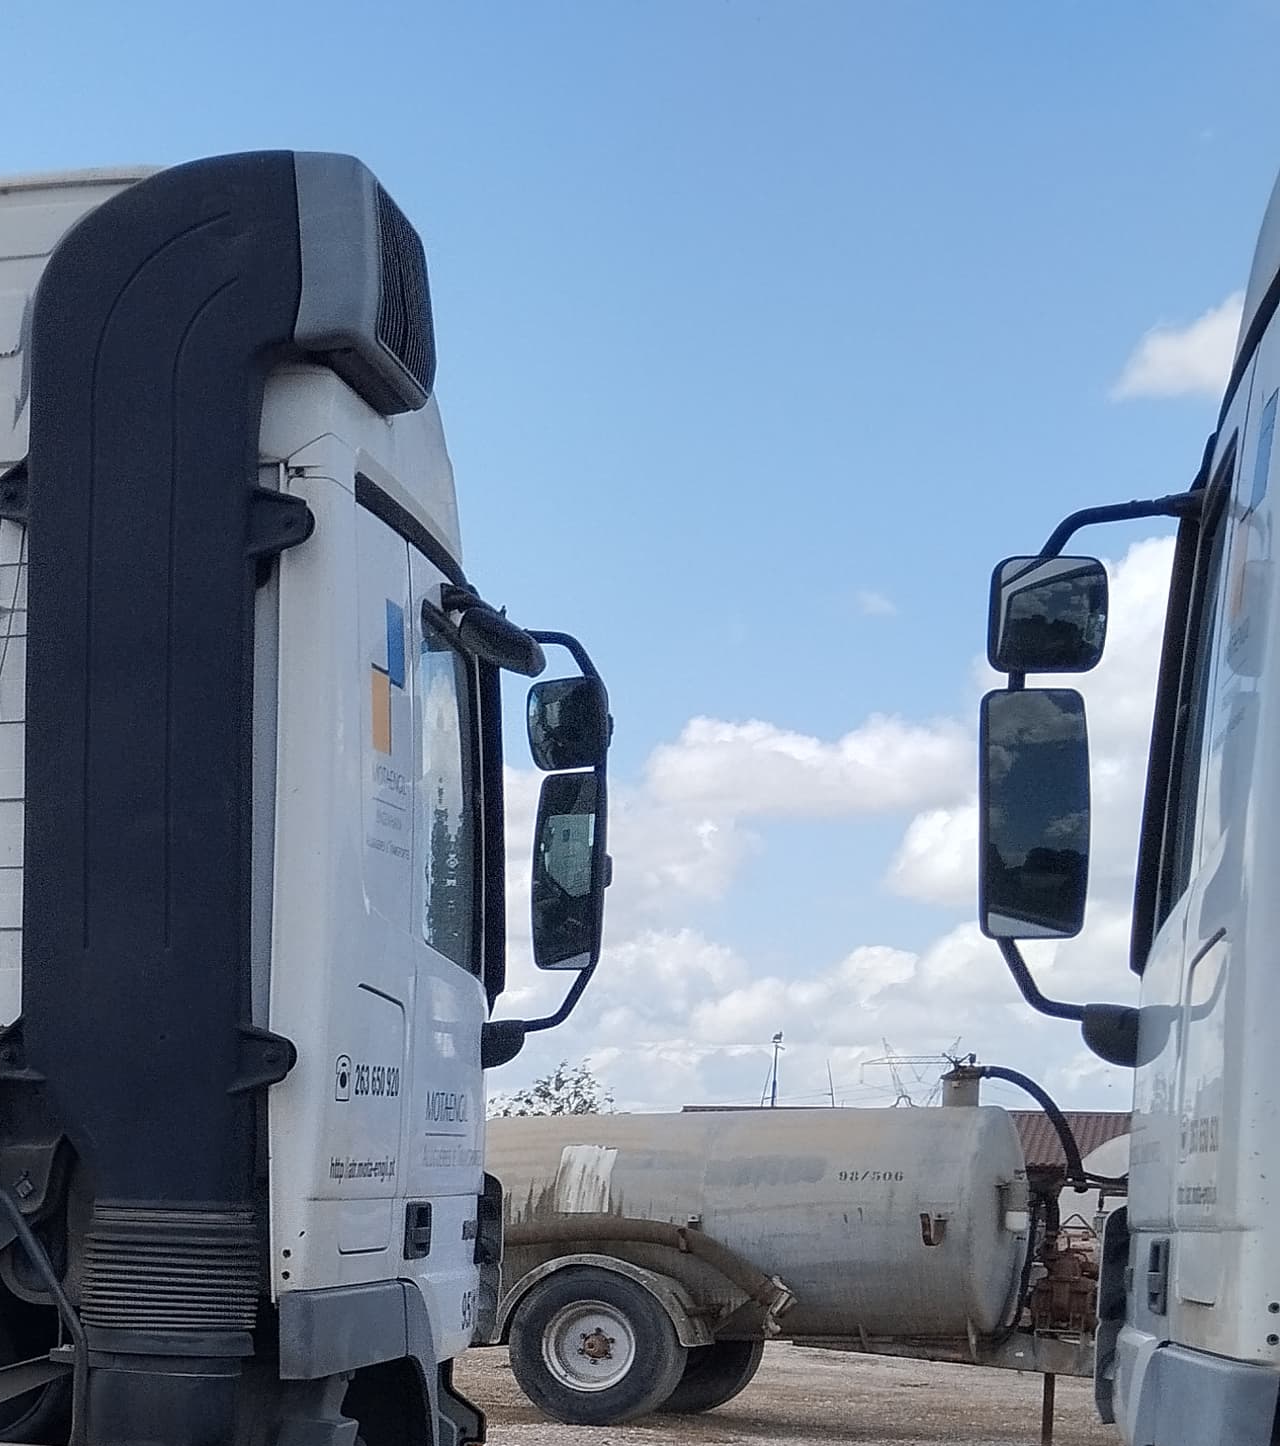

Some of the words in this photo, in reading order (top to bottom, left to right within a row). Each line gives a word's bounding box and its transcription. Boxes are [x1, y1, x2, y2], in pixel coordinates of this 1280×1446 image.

[354, 1063, 370, 1096] 263
[371, 1065, 386, 1097] 650
[386, 1066, 400, 1097] 920
[839, 1170, 904, 1182] 98/506
